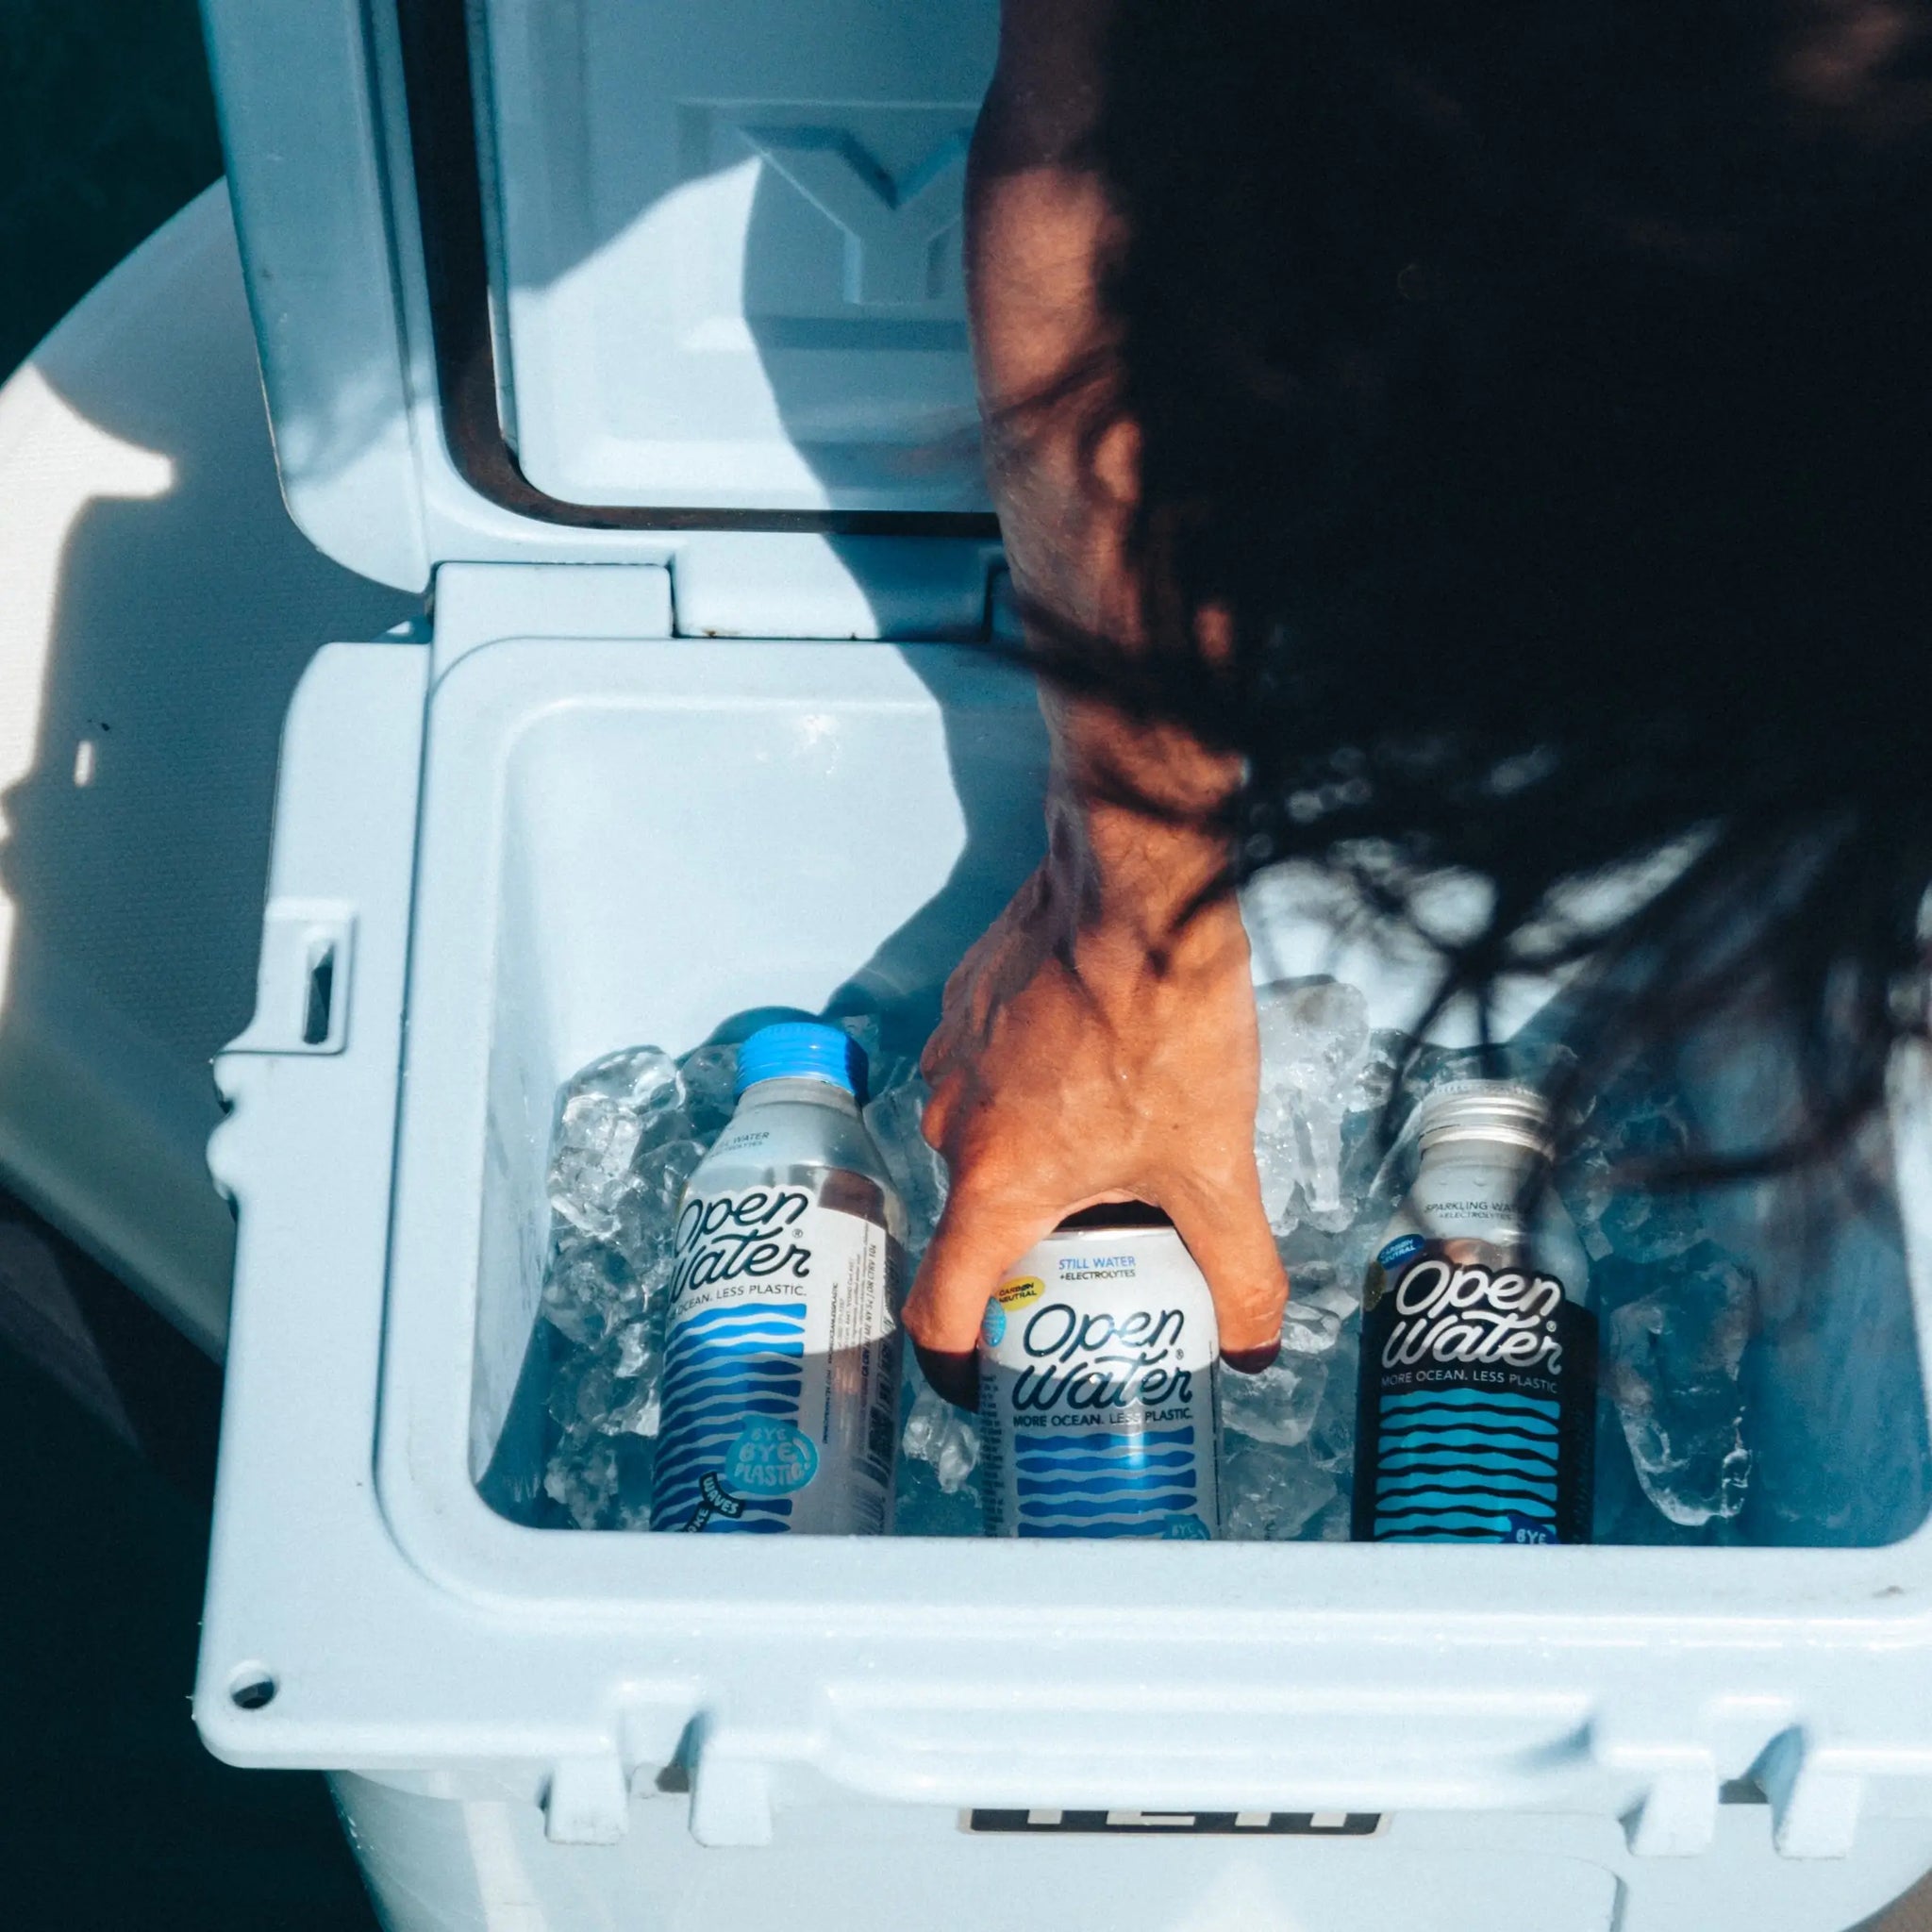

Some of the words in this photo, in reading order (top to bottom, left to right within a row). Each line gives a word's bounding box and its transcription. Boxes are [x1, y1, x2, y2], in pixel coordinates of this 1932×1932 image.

[733, 1132, 770, 1144] WATER
[1424, 1201, 1488, 1214] SPARKLING
[675, 1191, 808, 1257] Open
[1058, 1257, 1090, 1270] STILL
[1093, 1256, 1136, 1268] WATER
[716, 1285, 744, 1300] LESS
[748, 1284, 807, 1297] PLASTIC.
[998, 1290, 1038, 1304] NEUTRAL
[1396, 1259, 1561, 1319] Open
[1024, 1303, 1184, 1362] Open
[1381, 1309, 1562, 1375] Water
[1011, 1349, 1192, 1410] Water
[1381, 1373, 1412, 1388] MORE
[1416, 1369, 1468, 1382] OCEAN.
[1474, 1371, 1505, 1383] LESS
[1013, 1415, 1047, 1427] MORE
[1051, 1413, 1104, 1426] OCEAN.
[1109, 1412, 1140, 1424] LESS
[751, 1427, 787, 1440] BYE
[739, 1442, 798, 1463] BYE
[702, 1474, 740, 1515] WAVES
